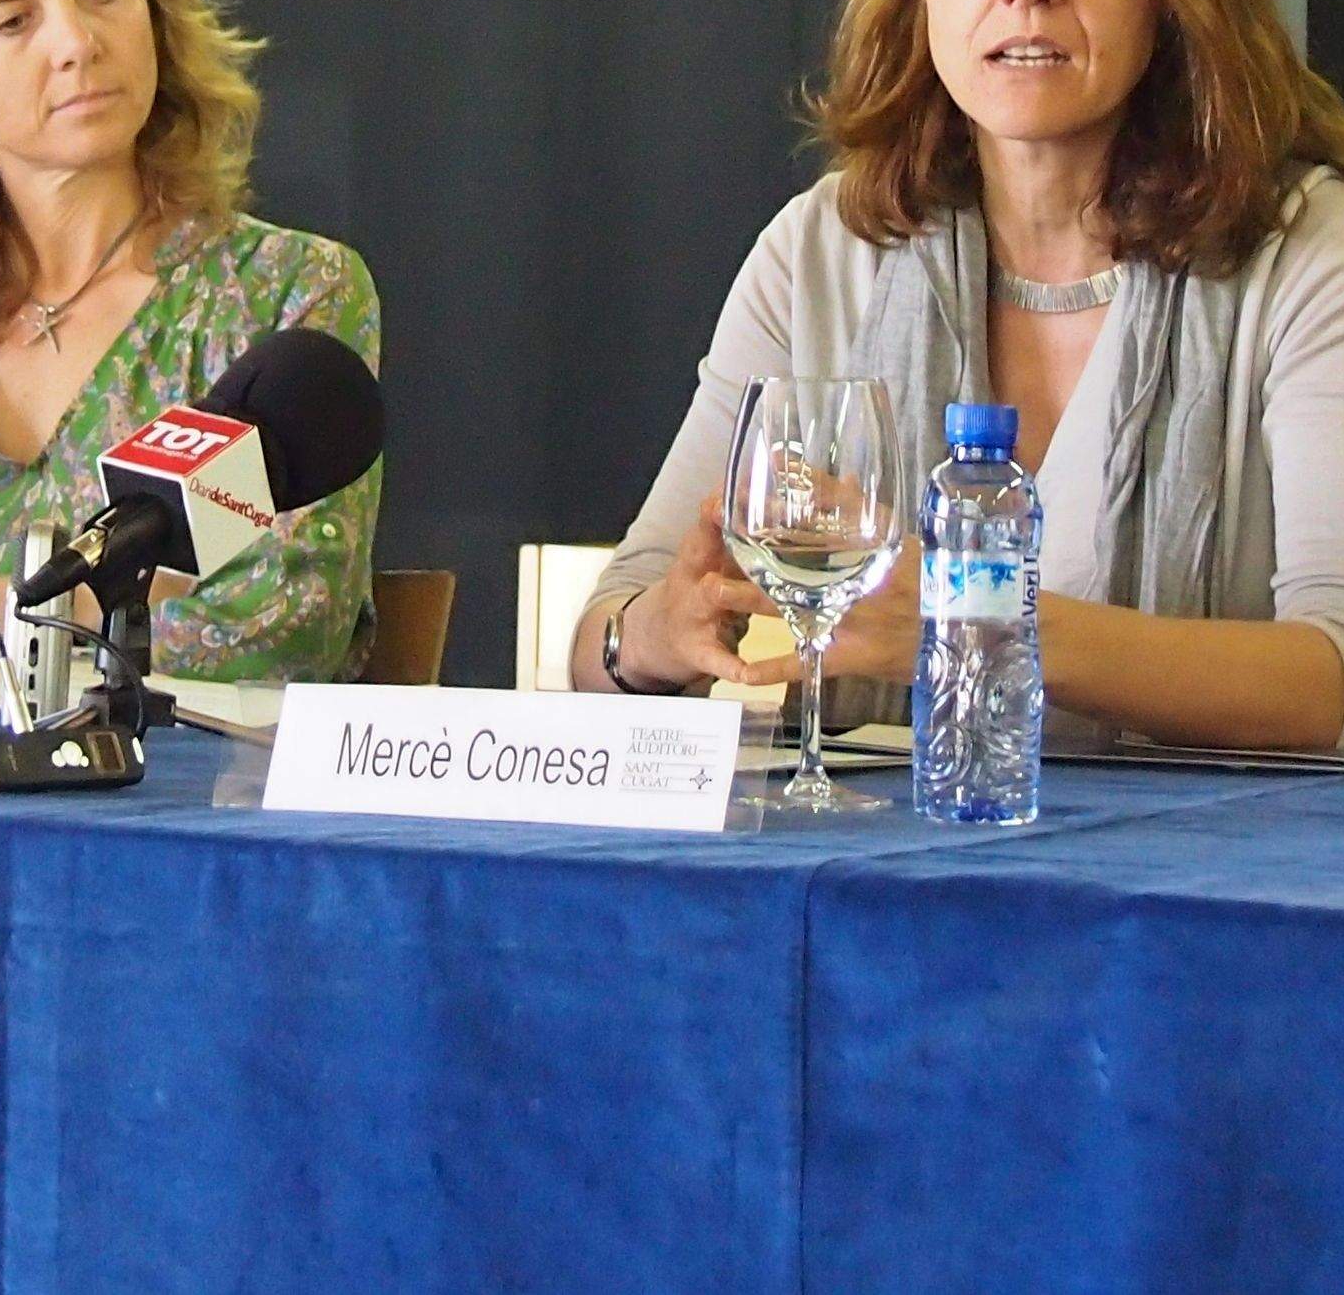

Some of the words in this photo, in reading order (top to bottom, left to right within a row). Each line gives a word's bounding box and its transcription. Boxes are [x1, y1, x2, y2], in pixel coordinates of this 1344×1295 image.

[141, 420, 231, 456] TOT
[628, 726, 686, 742] TEATRE
[336, 722, 455, 780] Mercè
[466, 728, 610, 788] Conesa
[623, 760, 665, 774] SANT
[620, 774, 673, 788] CUGAT
